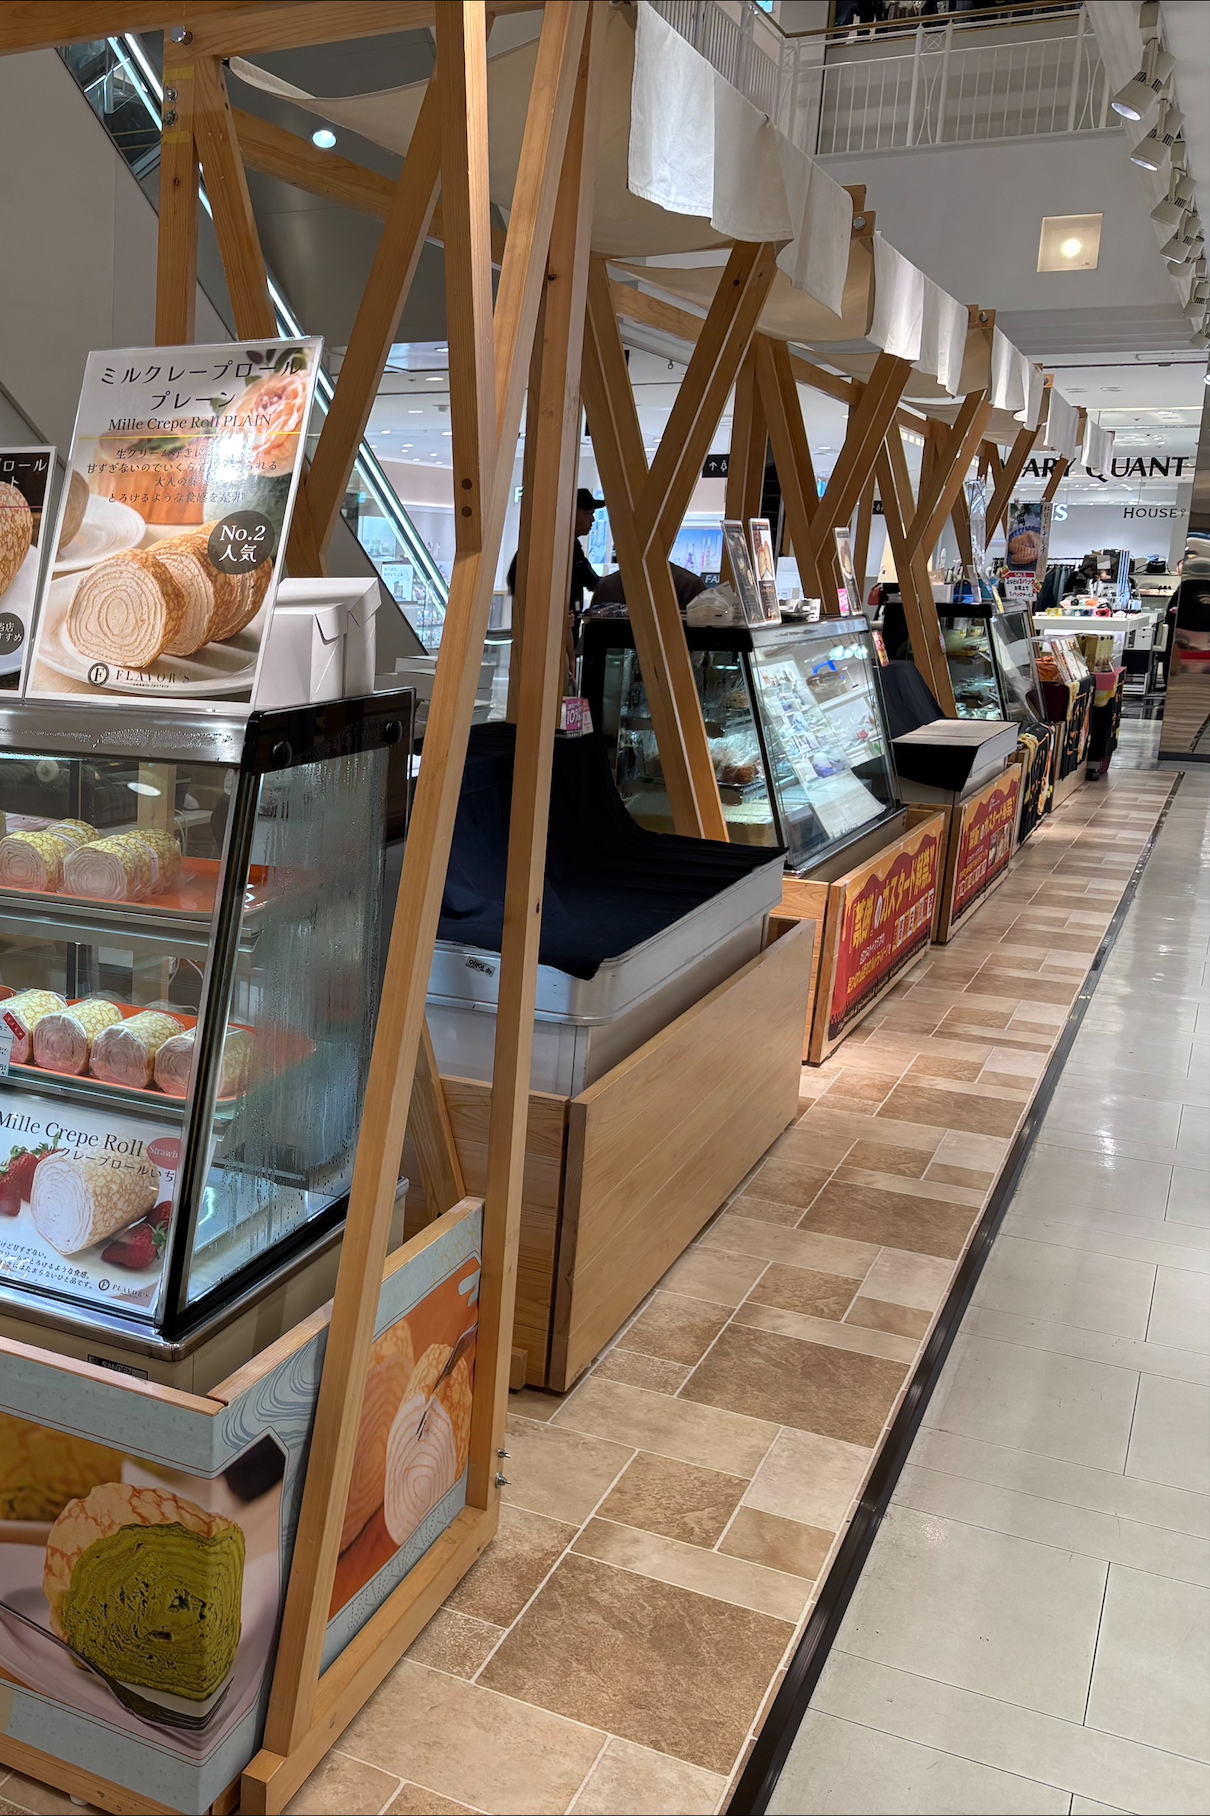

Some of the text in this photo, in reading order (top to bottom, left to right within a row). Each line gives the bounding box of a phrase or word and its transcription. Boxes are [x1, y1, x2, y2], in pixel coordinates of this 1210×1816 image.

[100, 359, 302, 385] ミルクレープロール
[150, 390, 236, 411] プレーン
[108, 413, 273, 434] Mille Crepe Roll PLAIN
[1123, 507, 1178, 519] HOUSE
[219, 524, 266, 542] No.2
[218, 544, 257, 563] 人気
[115, 669, 191, 684] FLAVOR'S
[45, 1121, 99, 1148] Crepe
[104, 1133, 144, 1158] Roll
